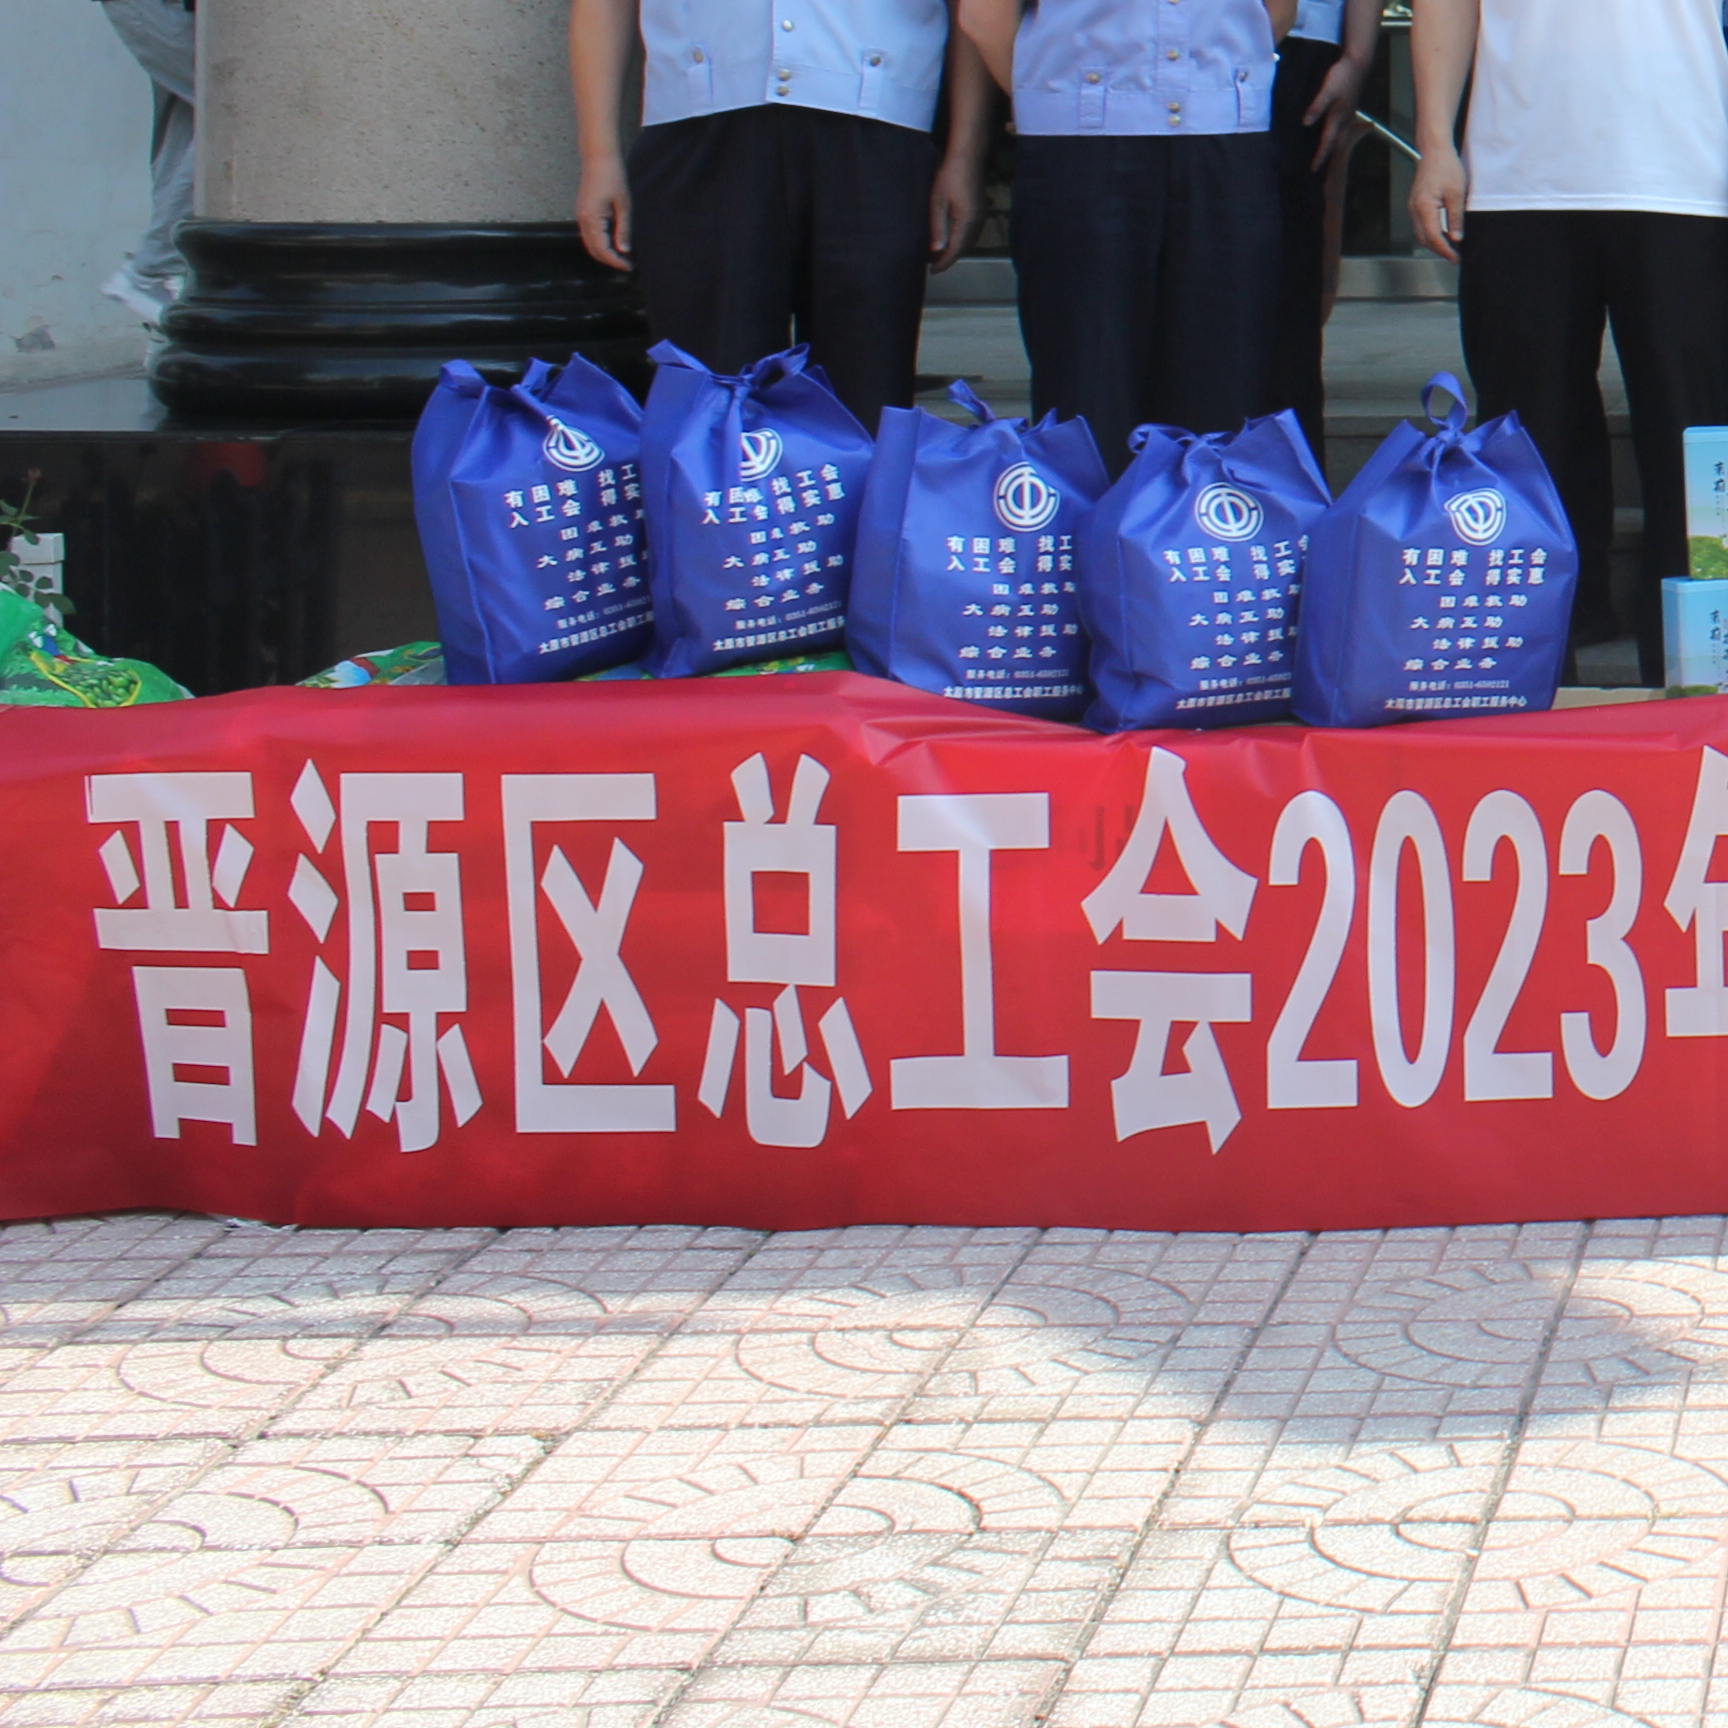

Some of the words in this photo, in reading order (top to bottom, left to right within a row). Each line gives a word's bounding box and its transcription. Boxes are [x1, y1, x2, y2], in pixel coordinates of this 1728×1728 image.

[504, 479, 578, 509] 有困难
[598, 463, 637, 488] 找工
[703, 486, 761, 508] 有困难
[772, 463, 839, 496] 找工会
[510, 500, 581, 529] 入工会
[600, 483, 640, 508] 得实
[702, 505, 769, 526] 入工会
[778, 482, 845, 516] 得实惠
[749, 513, 835, 545] 困难救助
[537, 534, 634, 569] 大病互助
[723, 540, 817, 569] 大病互助
[947, 535, 1016, 554] 有困难
[1038, 535, 1072, 553] 找工
[568, 550, 648, 583] 法律援
[947, 555, 1016, 574] 入工会
[1037, 553, 1073, 572] 得实
[1163, 546, 1230, 566] 有困难
[1402, 548, 1469, 567] 有困难
[1488, 548, 1548, 567] 找工会
[751, 555, 843, 588] 法律援助
[1169, 565, 1233, 583] 入工会
[1254, 559, 1296, 580] 得实
[1399, 568, 1465, 586] 入工会
[1485, 568, 1545, 586] 得实惠
[543, 576, 640, 612] 综合业务
[724, 582, 824, 612] 综合业务
[1440, 595, 1528, 609] 困难救助
[962, 603, 1059, 617] 大病互助
[1189, 607, 1284, 627] 大病互助
[538, 612, 653, 654] 太原市晋源区总工会职工服
[988, 623, 1078, 638] 法律援助
[1410, 616, 1503, 630] 大病互助
[712, 616, 845, 653] 太原市晋源区总工会职工服务
[1433, 636, 1524, 650] 法律援助
[959, 645, 1056, 660] 综合业务
[1190, 650, 1284, 671] 综合业务
[1403, 657, 1497, 670] 综合业务
[1176, 688, 1292, 710] 太原市晋源区总工会职工服
